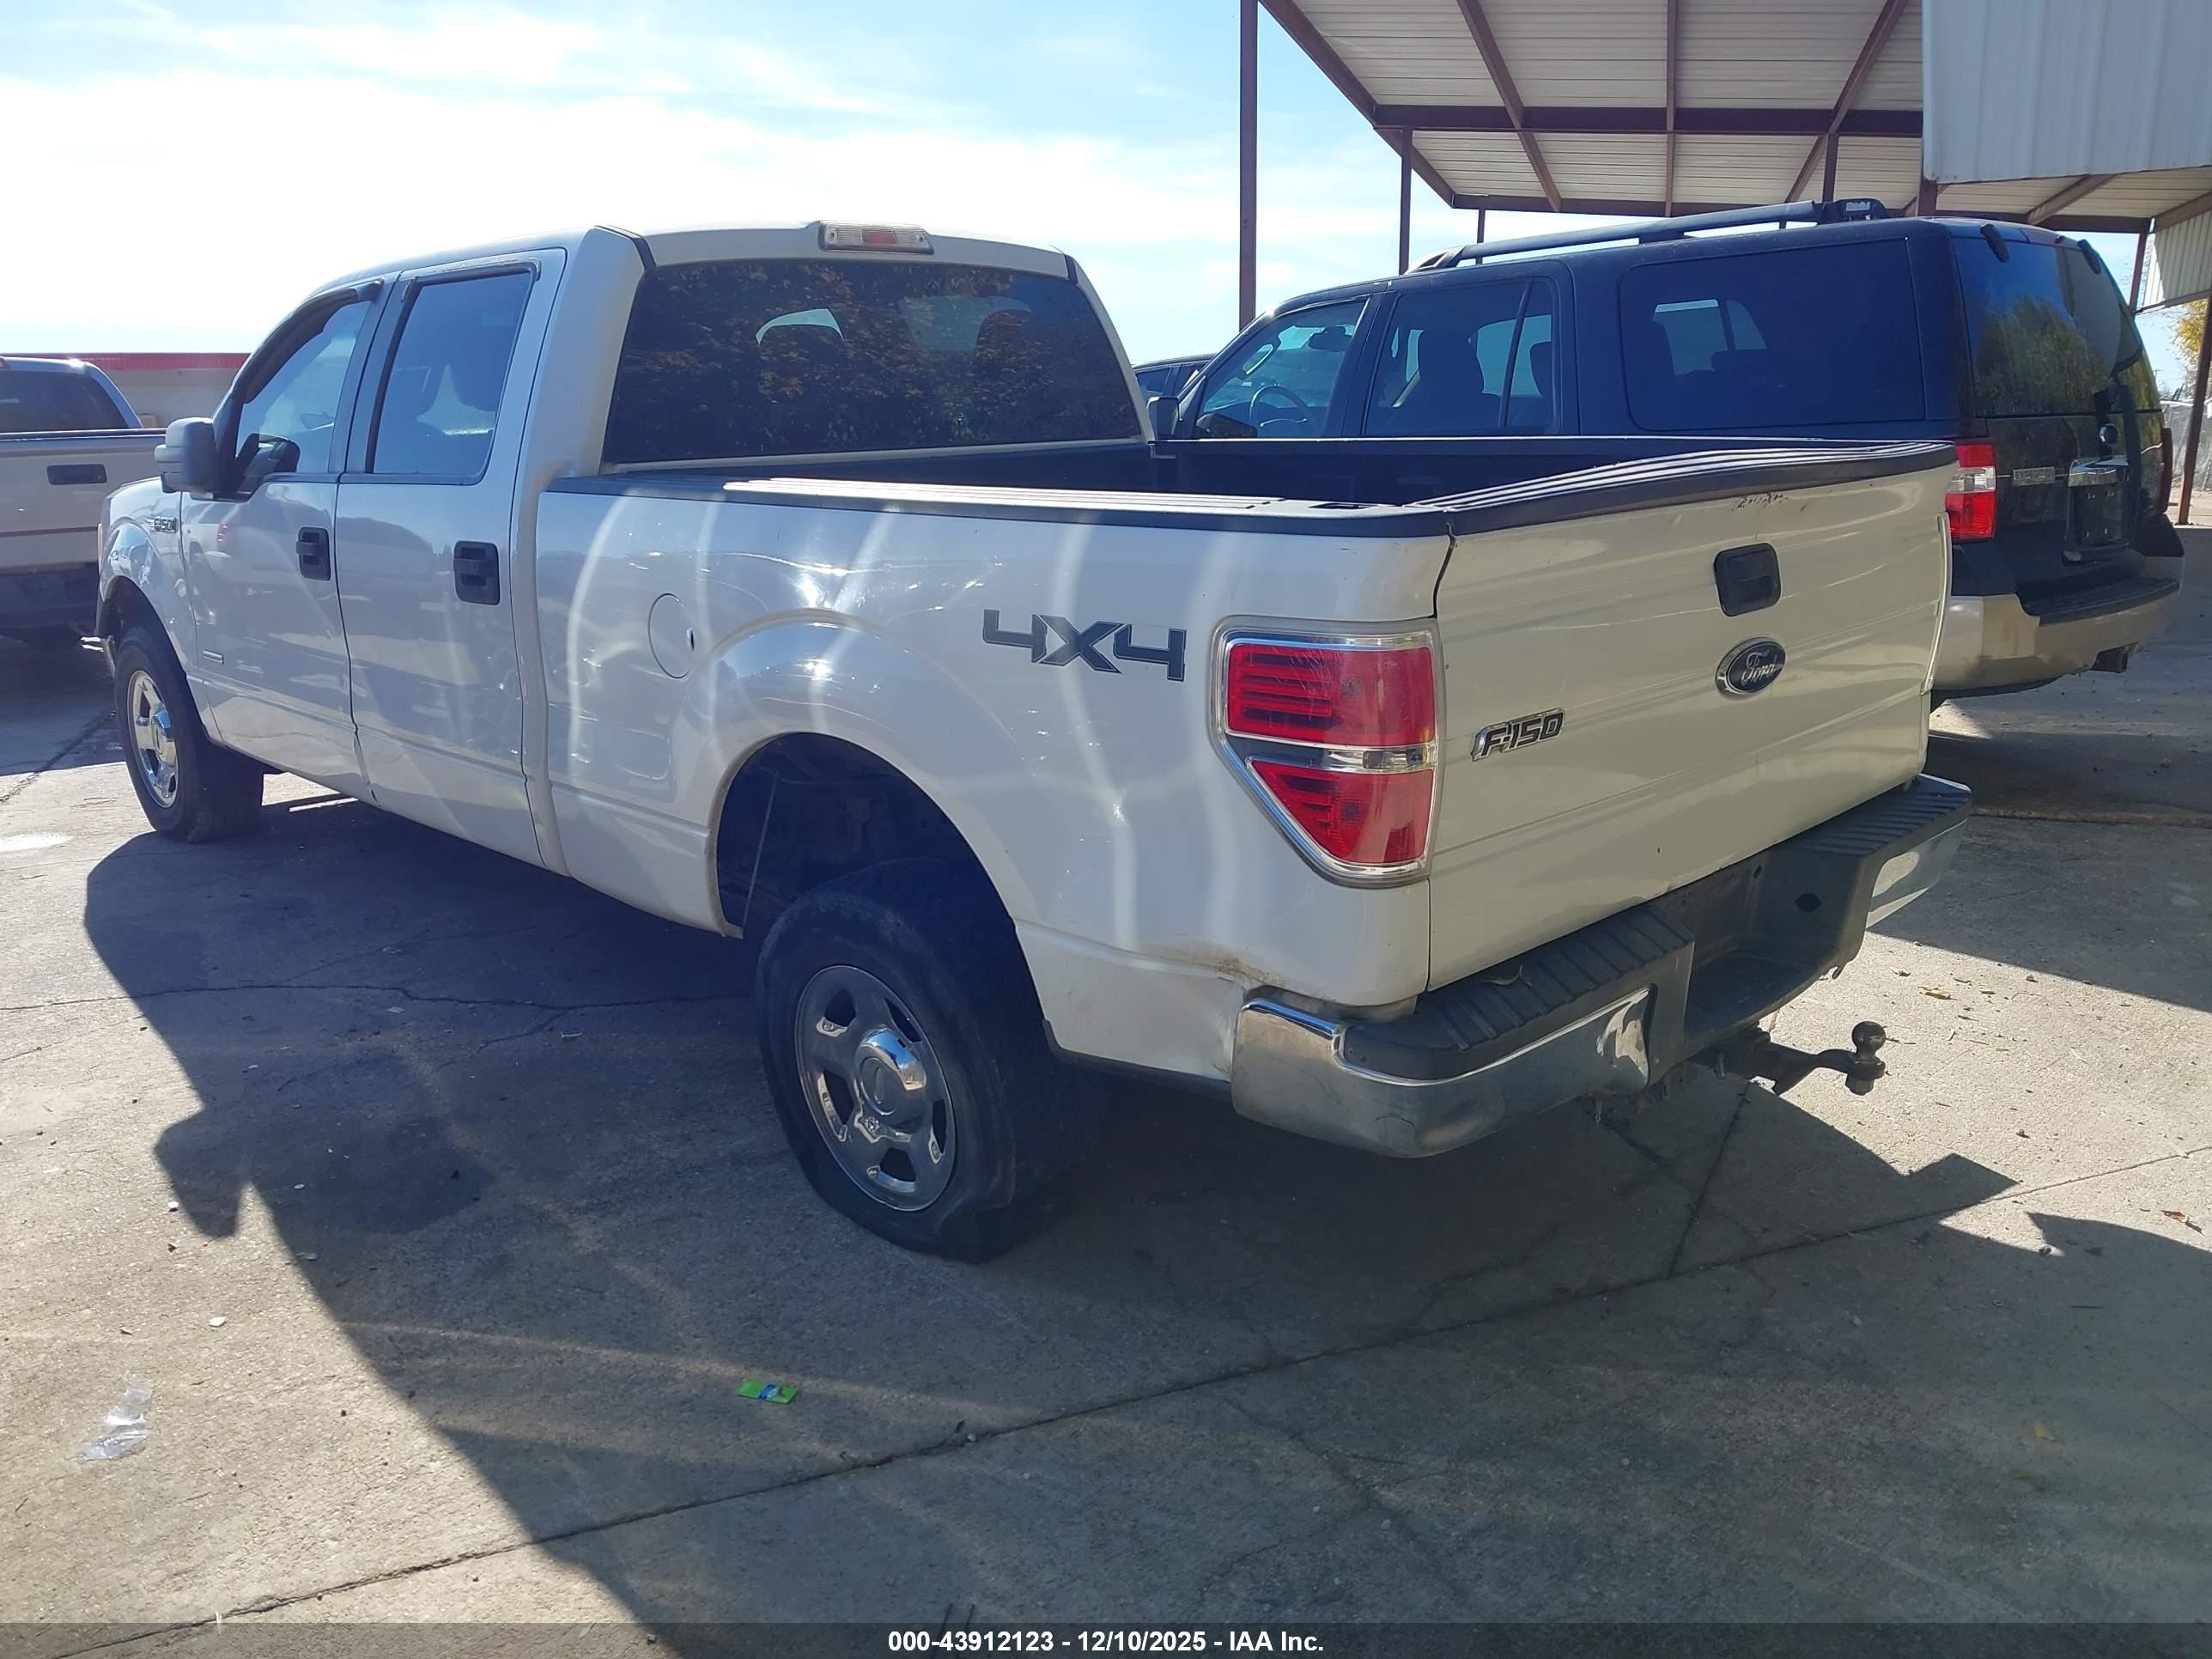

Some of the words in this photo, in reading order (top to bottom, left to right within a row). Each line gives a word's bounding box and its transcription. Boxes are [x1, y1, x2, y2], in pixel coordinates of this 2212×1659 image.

[983, 609, 1187, 682] 4X4
[1741, 649, 1778, 686] Ford
[1477, 711, 1564, 757] F-150
